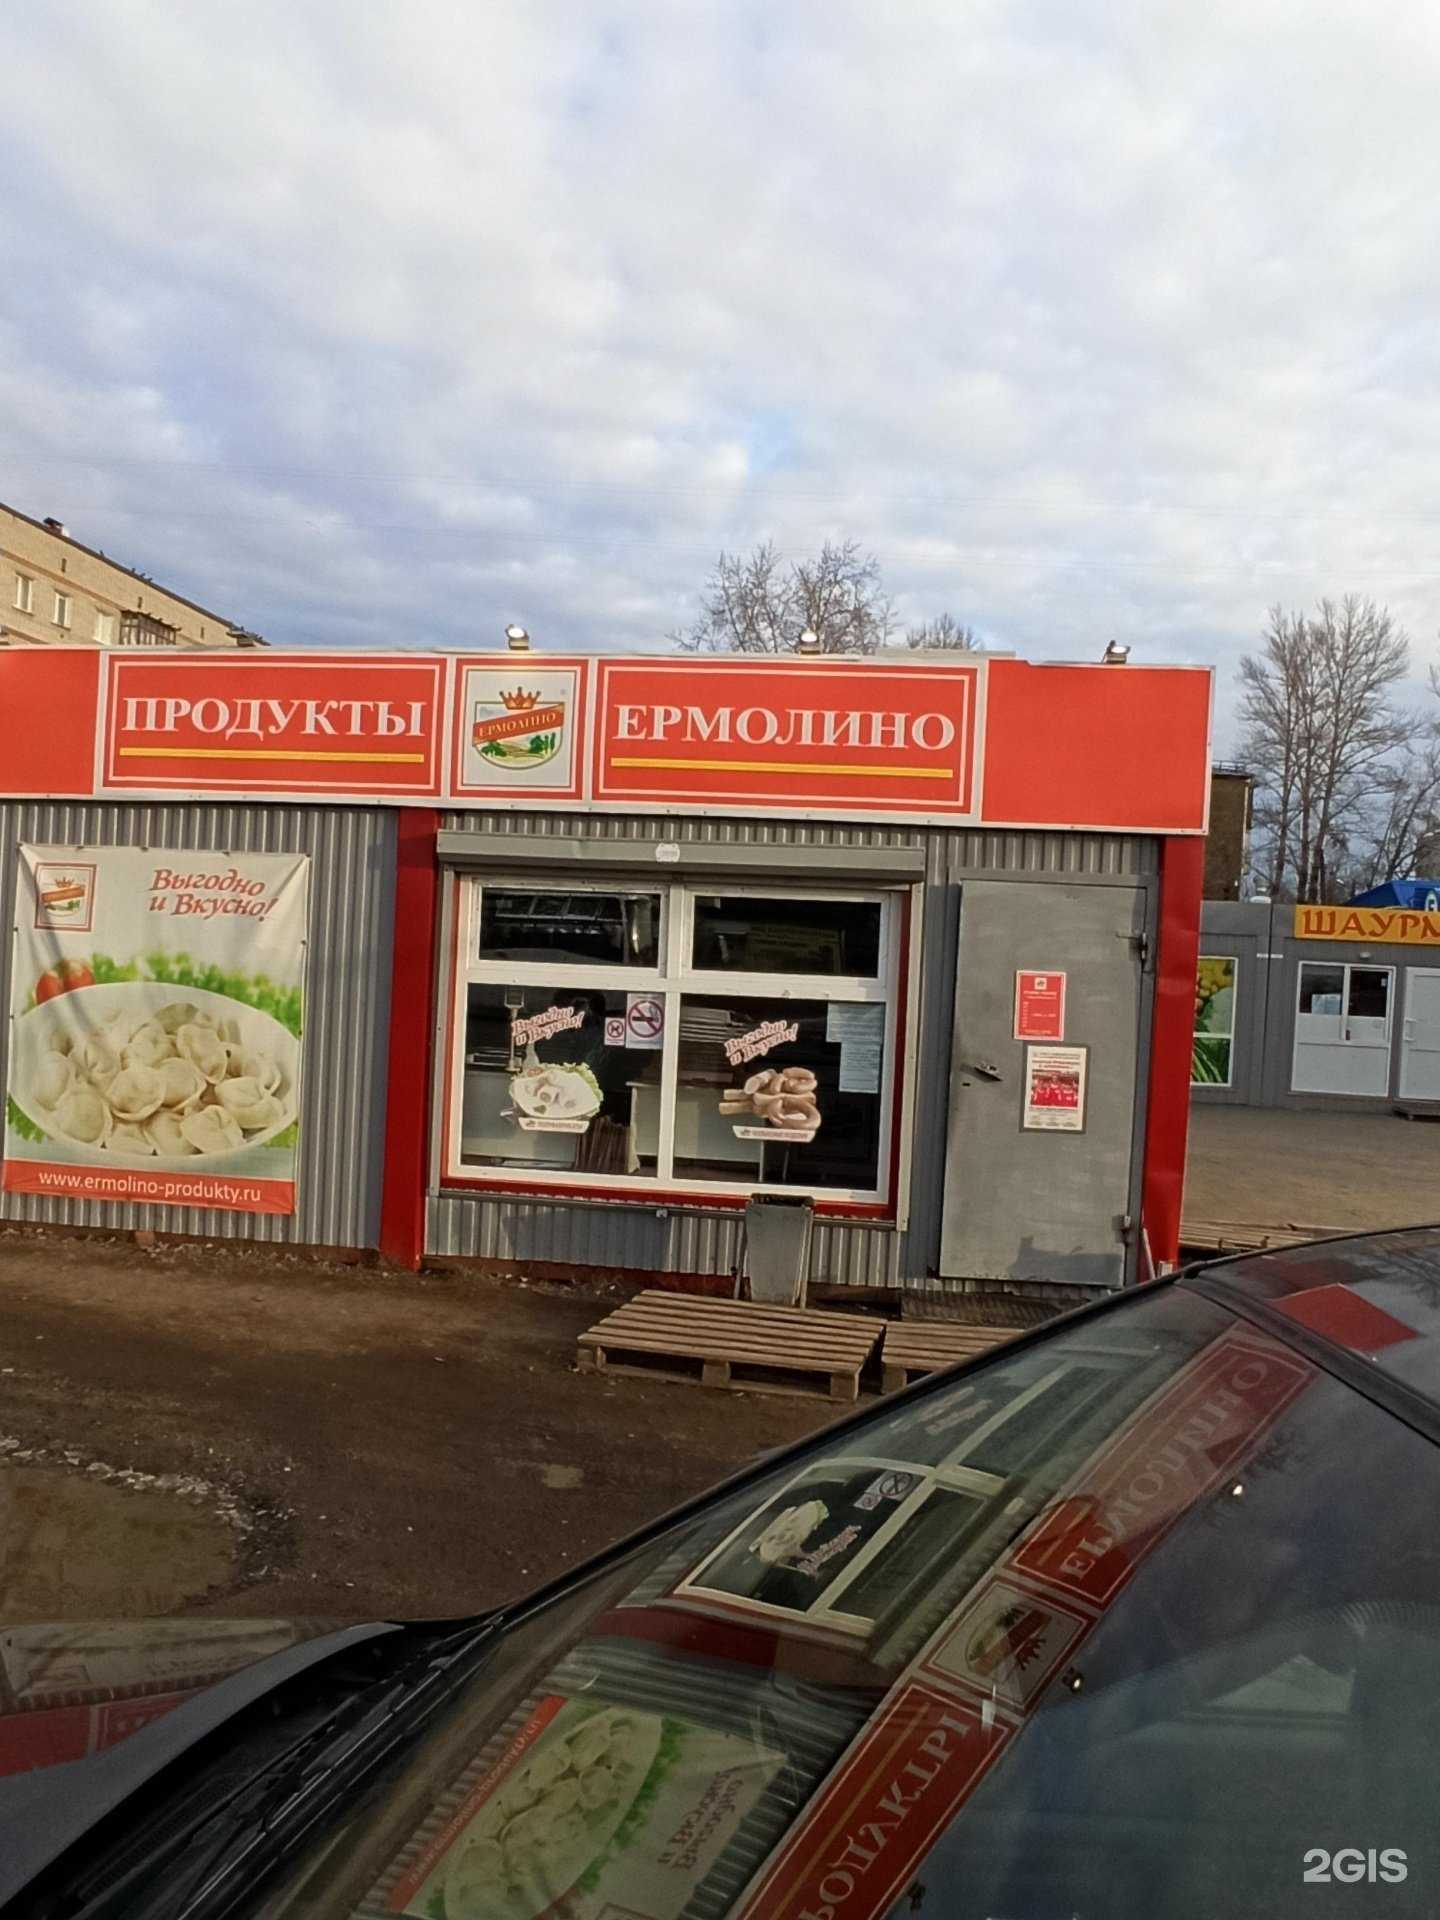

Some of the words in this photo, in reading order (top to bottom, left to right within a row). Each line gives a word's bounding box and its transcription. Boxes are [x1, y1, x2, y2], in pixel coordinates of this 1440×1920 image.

[121, 697, 427, 741] ПРОДУКТЫ
[479, 712, 556, 737] ЕРМОЛИНО
[612, 704, 955, 750] ЕРМОЛИНО
[149, 868, 265, 896] Выгодно
[149, 895, 167, 911] и
[170, 893, 279, 922] Вкусно!
[38, 1171, 261, 1203] www.ermolino-produkty.ru
